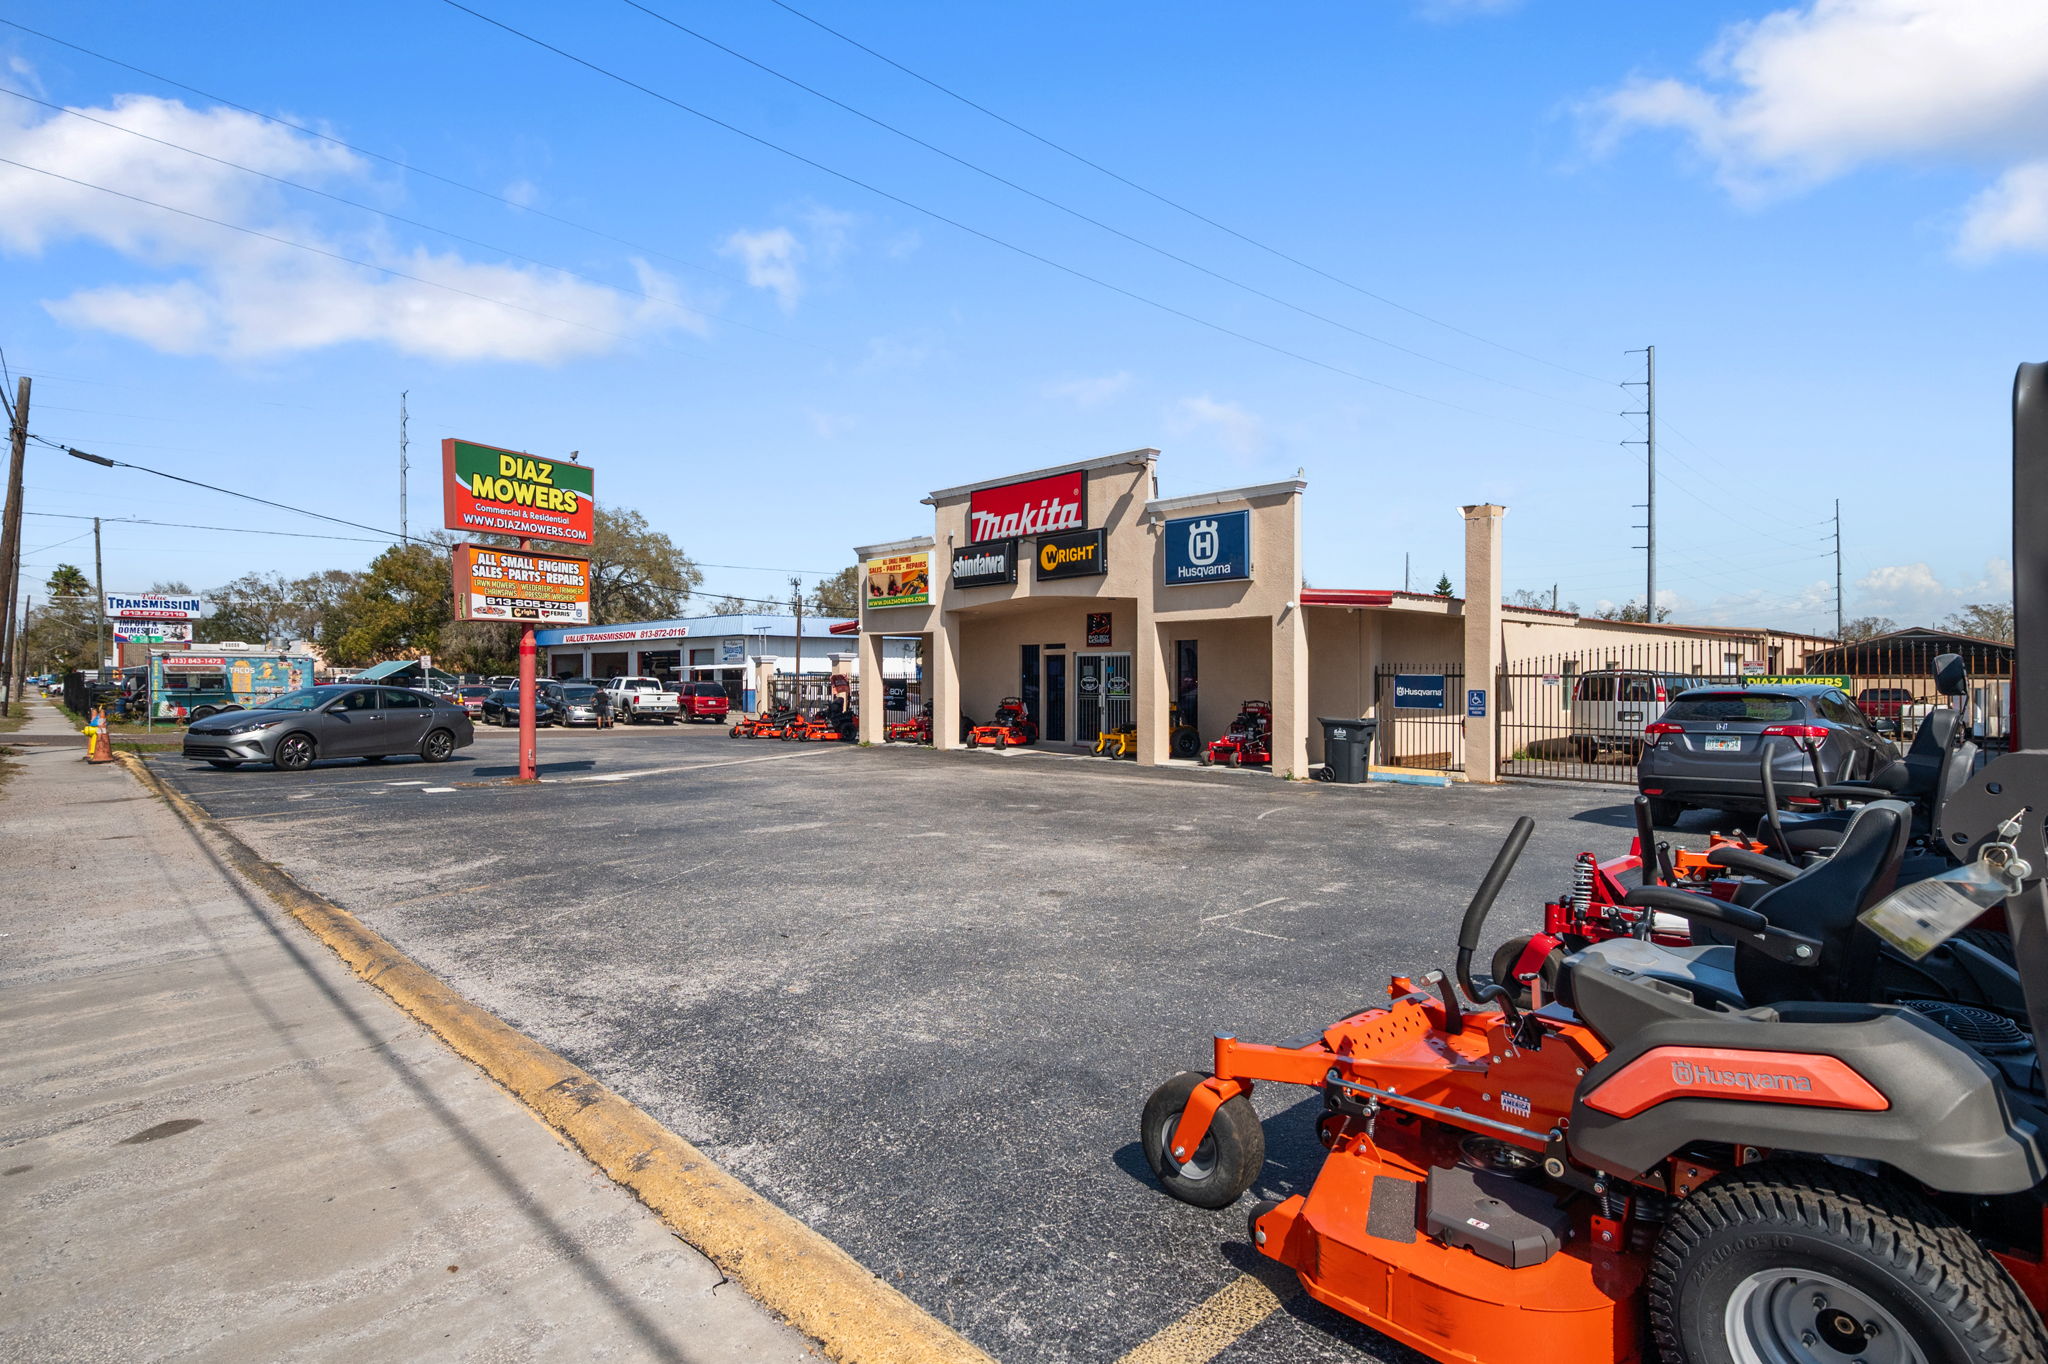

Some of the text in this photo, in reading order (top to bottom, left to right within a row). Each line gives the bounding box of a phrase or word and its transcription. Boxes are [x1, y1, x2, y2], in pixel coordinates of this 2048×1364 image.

[499, 454, 553, 485] DIAZ
[472, 473, 578, 513] MOWERS
[475, 503, 521, 518] Commercial
[530, 511, 570, 525] Residential
[463, 513, 587, 540] WWW.DIAZMOWERS.COM
[477, 552, 579, 574] ALL SMALL ENGINES
[906, 561, 927, 569] REPAIRS
[953, 553, 1005, 578] shindaiwa
[1178, 563, 1231, 578] Husqvarna
[472, 564, 502, 579] SALES
[508, 568, 540, 583] PARTS
[546, 572, 584, 586] REPAIRS
[491, 580, 516, 589] MOWERS
[108, 597, 200, 611] TRANSMISSION
[118, 627, 159, 635] DOMESIC
[565, 627, 686, 643] VALUE TRANSMISSION 813-872-0116
[1781, 678, 1843, 687] MOWERS
[1404, 688, 1442, 696] Husqvarna
[1694, 1066, 1811, 1091] Husqvarna
[1502, 1098, 1529, 1111] AMERICA
